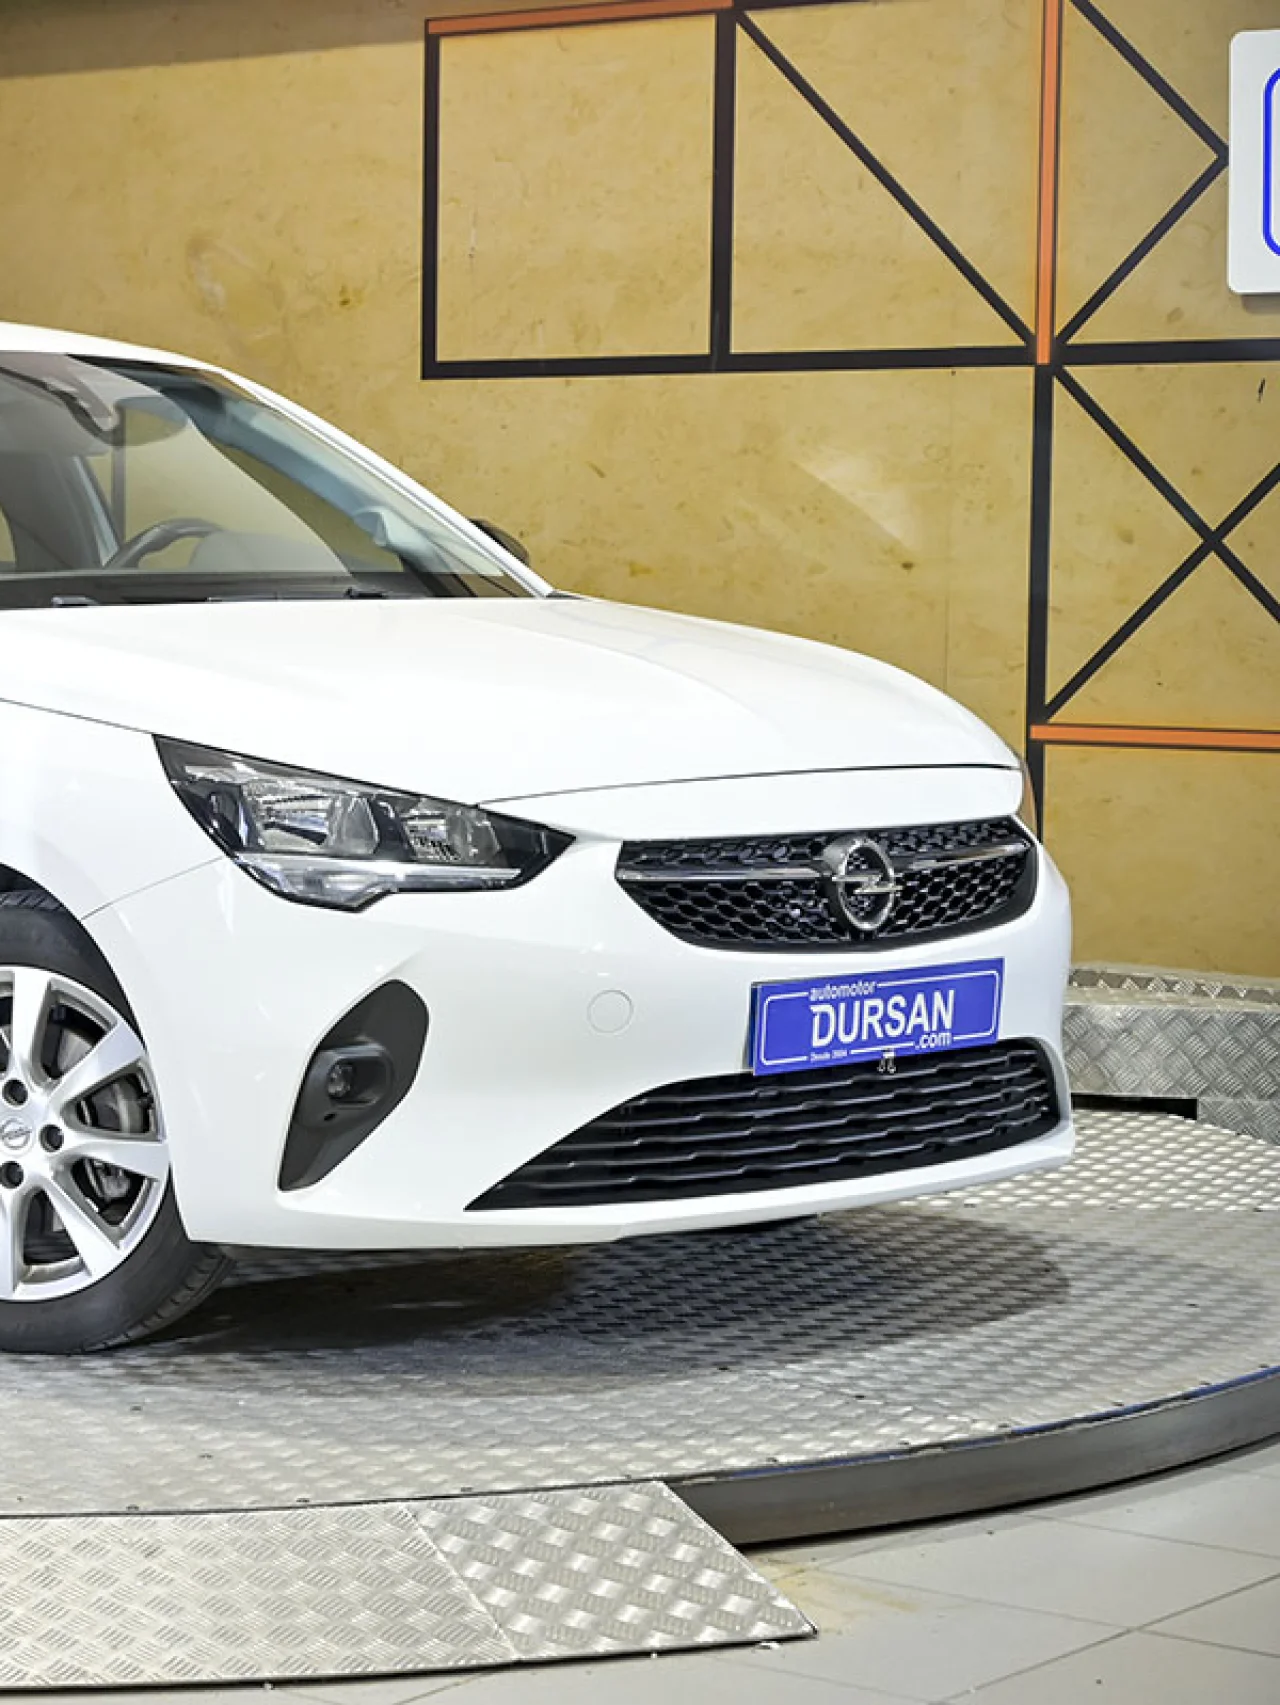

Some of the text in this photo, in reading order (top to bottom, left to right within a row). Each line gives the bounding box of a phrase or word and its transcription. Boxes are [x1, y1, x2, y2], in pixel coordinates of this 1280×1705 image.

[809, 980, 876, 1001] automotor
[810, 989, 955, 1047] DURSAN
[914, 1032, 951, 1050] .com
